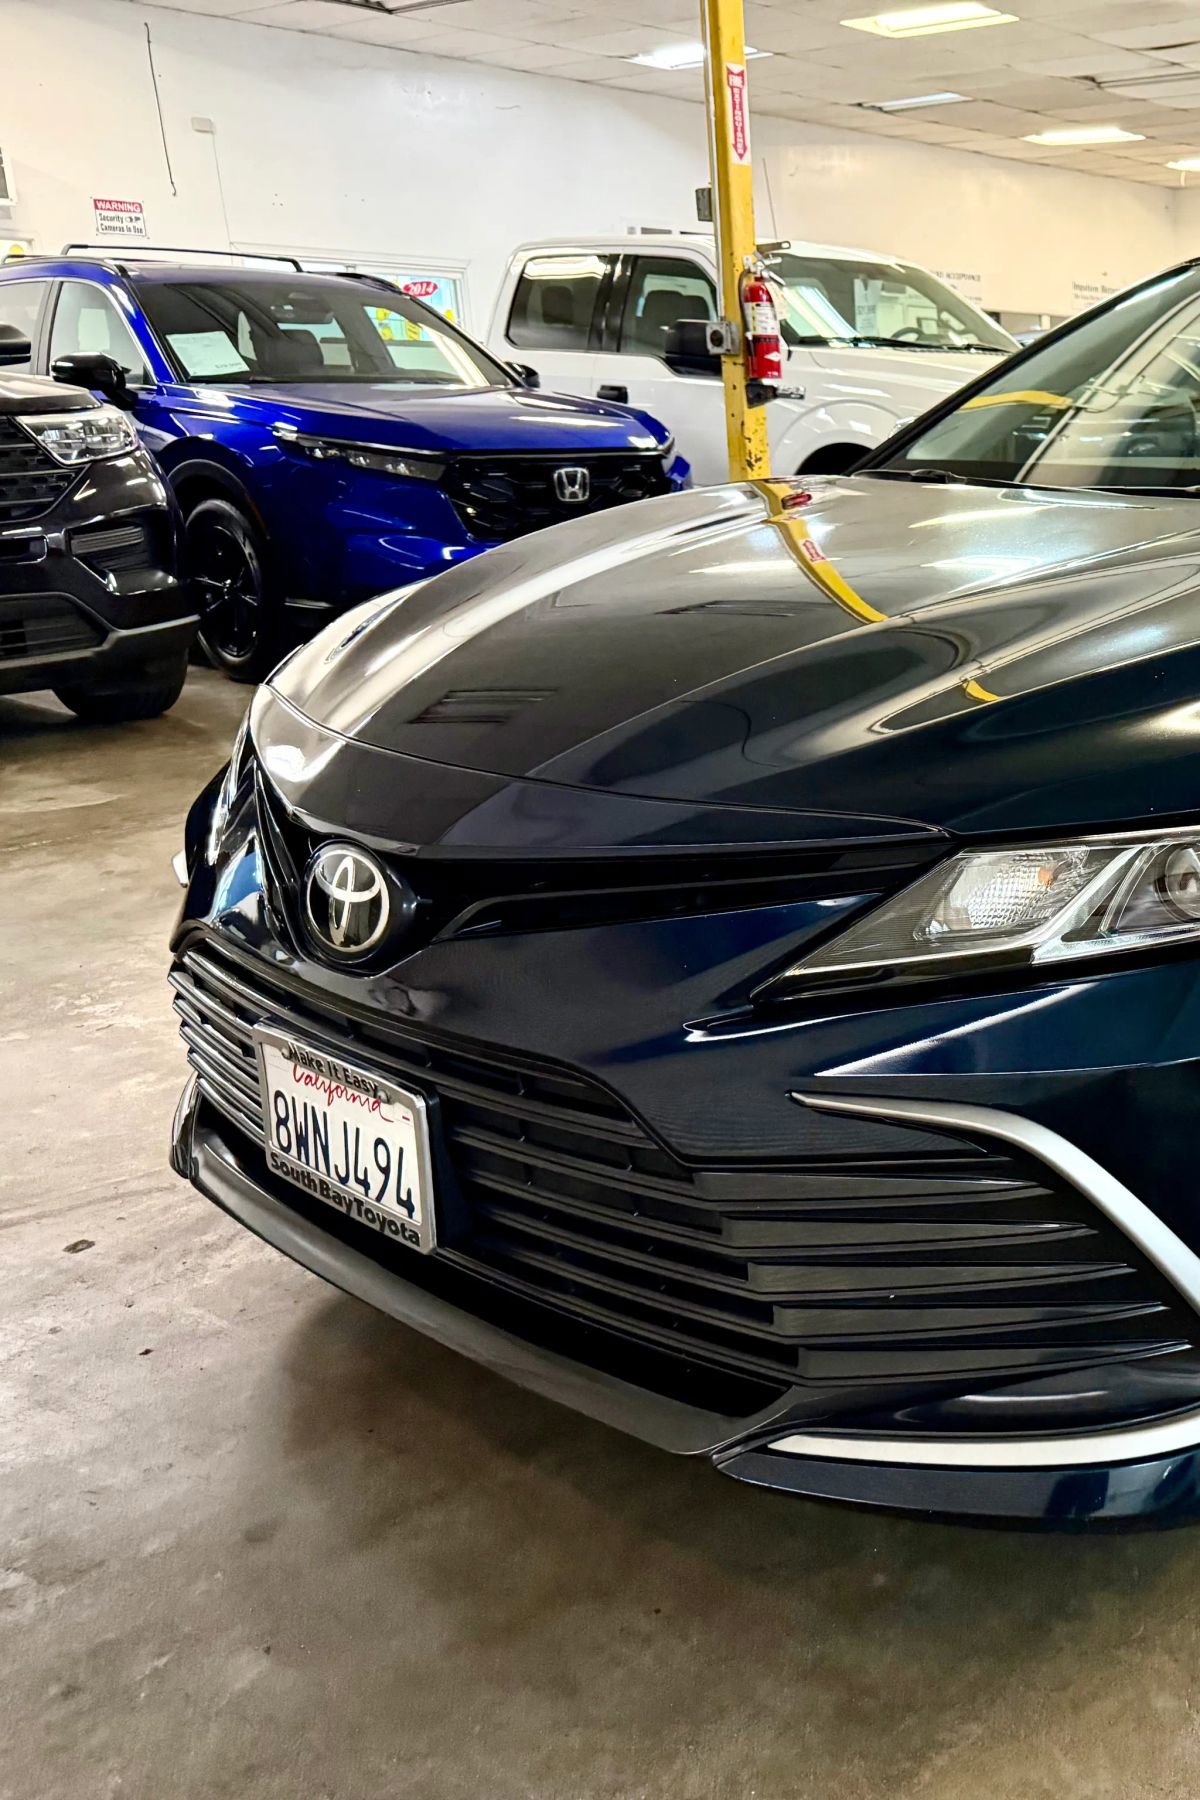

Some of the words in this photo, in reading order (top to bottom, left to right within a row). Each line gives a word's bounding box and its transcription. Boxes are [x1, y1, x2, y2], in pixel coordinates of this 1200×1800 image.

[95, 200, 141, 213] WARNING
[99, 213, 124, 224] Security
[100, 223, 125, 233] Cameras
[409, 282, 434, 295] 2014
[288, 1042, 324, 1073] Make
[327, 1060, 339, 1081] It
[344, 1067, 378, 1099] Easy
[293, 1064, 394, 1123] California
[274, 1090, 415, 1219] 8WNJ494
